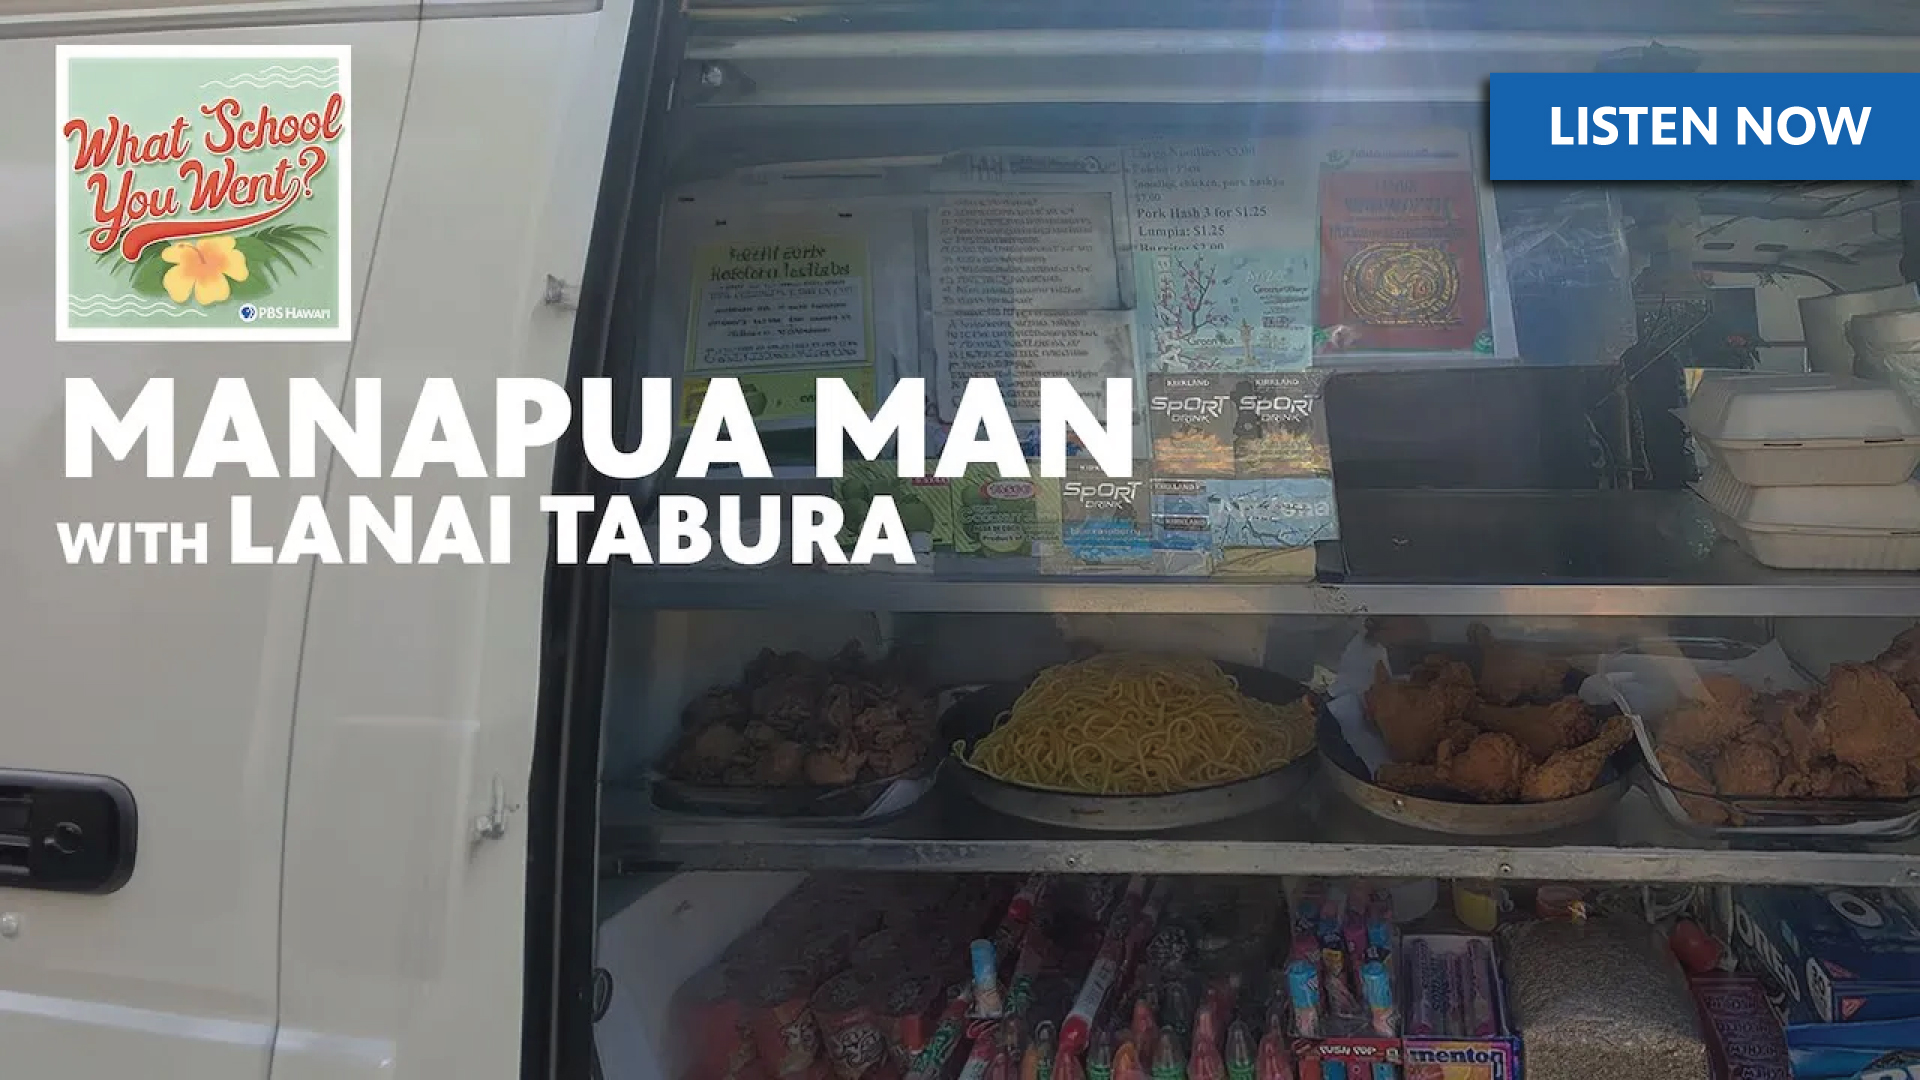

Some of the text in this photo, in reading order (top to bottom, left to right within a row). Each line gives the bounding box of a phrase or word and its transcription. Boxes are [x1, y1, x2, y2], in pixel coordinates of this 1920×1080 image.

[1136, 206, 1268, 219] Pork Hash 3 for $1.25
[1139, 224, 1226, 239] Lumpia: $1.25
[1166, 379, 1211, 387] KIRKLAND
[1254, 378, 1300, 387] KIRKLAND
[1171, 413, 1211, 424] DRINK
[1261, 413, 1301, 424] DRINK
[1085, 500, 1124, 510] DRINK
